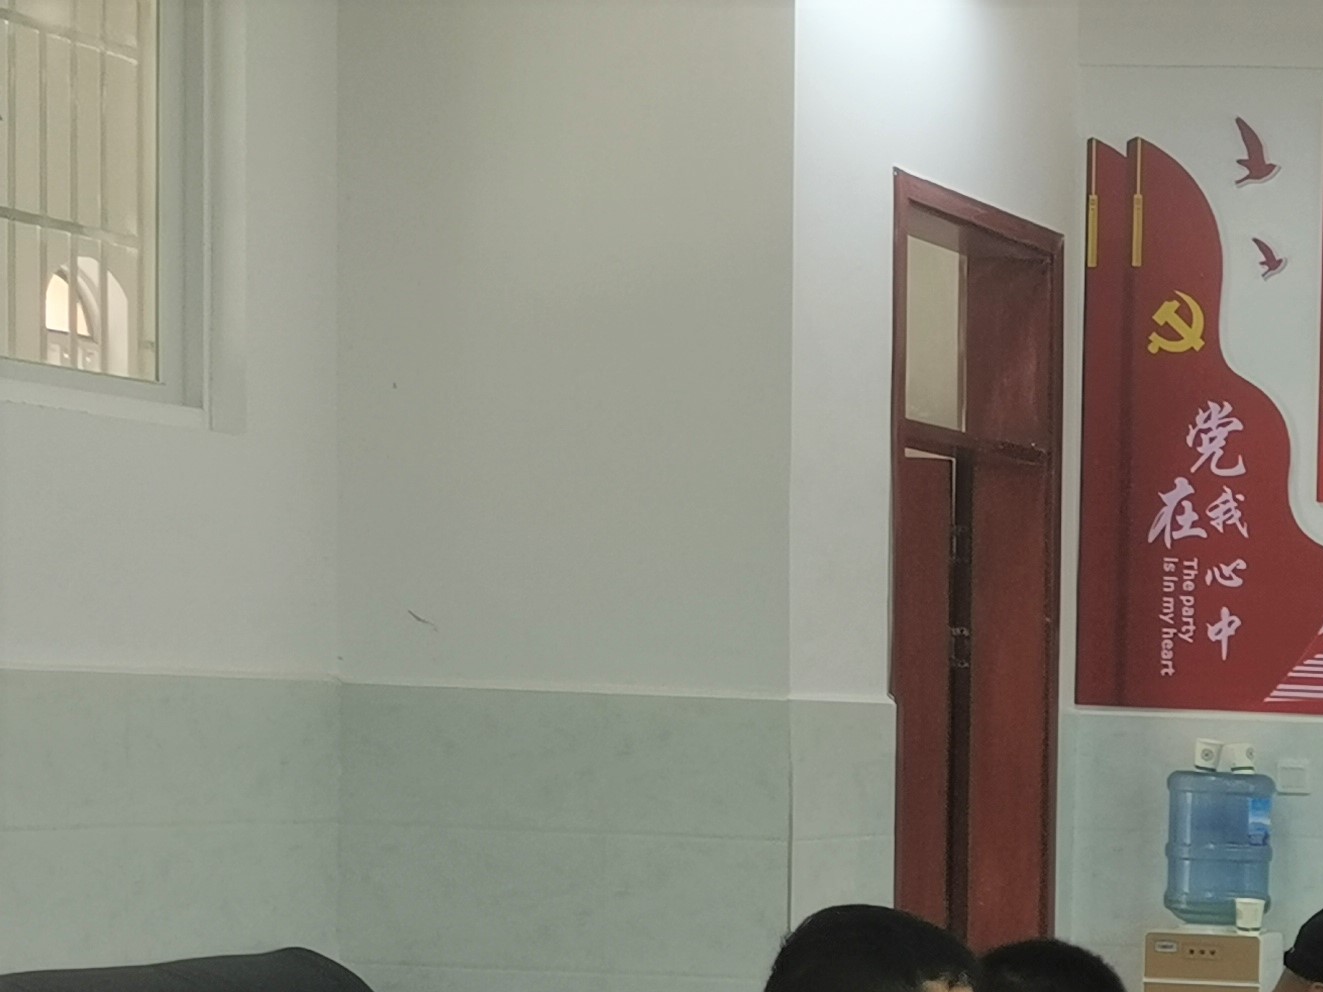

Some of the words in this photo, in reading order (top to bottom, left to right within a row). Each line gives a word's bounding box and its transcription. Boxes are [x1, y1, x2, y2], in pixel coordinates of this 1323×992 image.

[1183, 558, 1199, 592] The
[1159, 597, 1177, 629] my
[1178, 596, 1196, 644] party
[1160, 630, 1176, 677] heart
